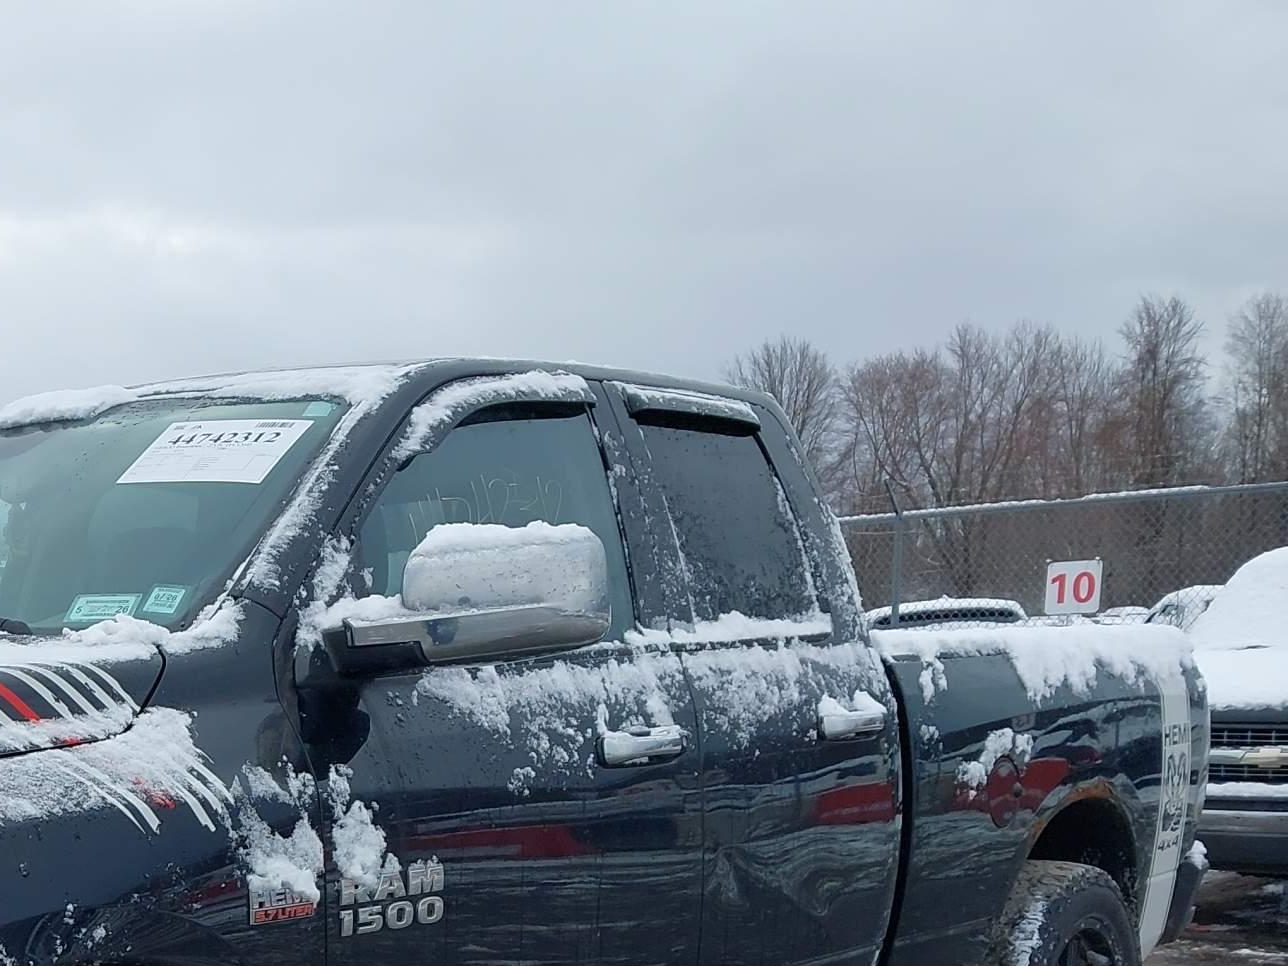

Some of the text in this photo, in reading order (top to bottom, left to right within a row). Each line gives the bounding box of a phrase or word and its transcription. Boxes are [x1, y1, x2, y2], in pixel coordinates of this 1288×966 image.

[168, 431, 282, 446] 44742312
[1050, 571, 1096, 605] 10
[1164, 722, 1190, 746] HEMI
[339, 864, 445, 906] RAM
[339, 896, 444, 937] 1500
